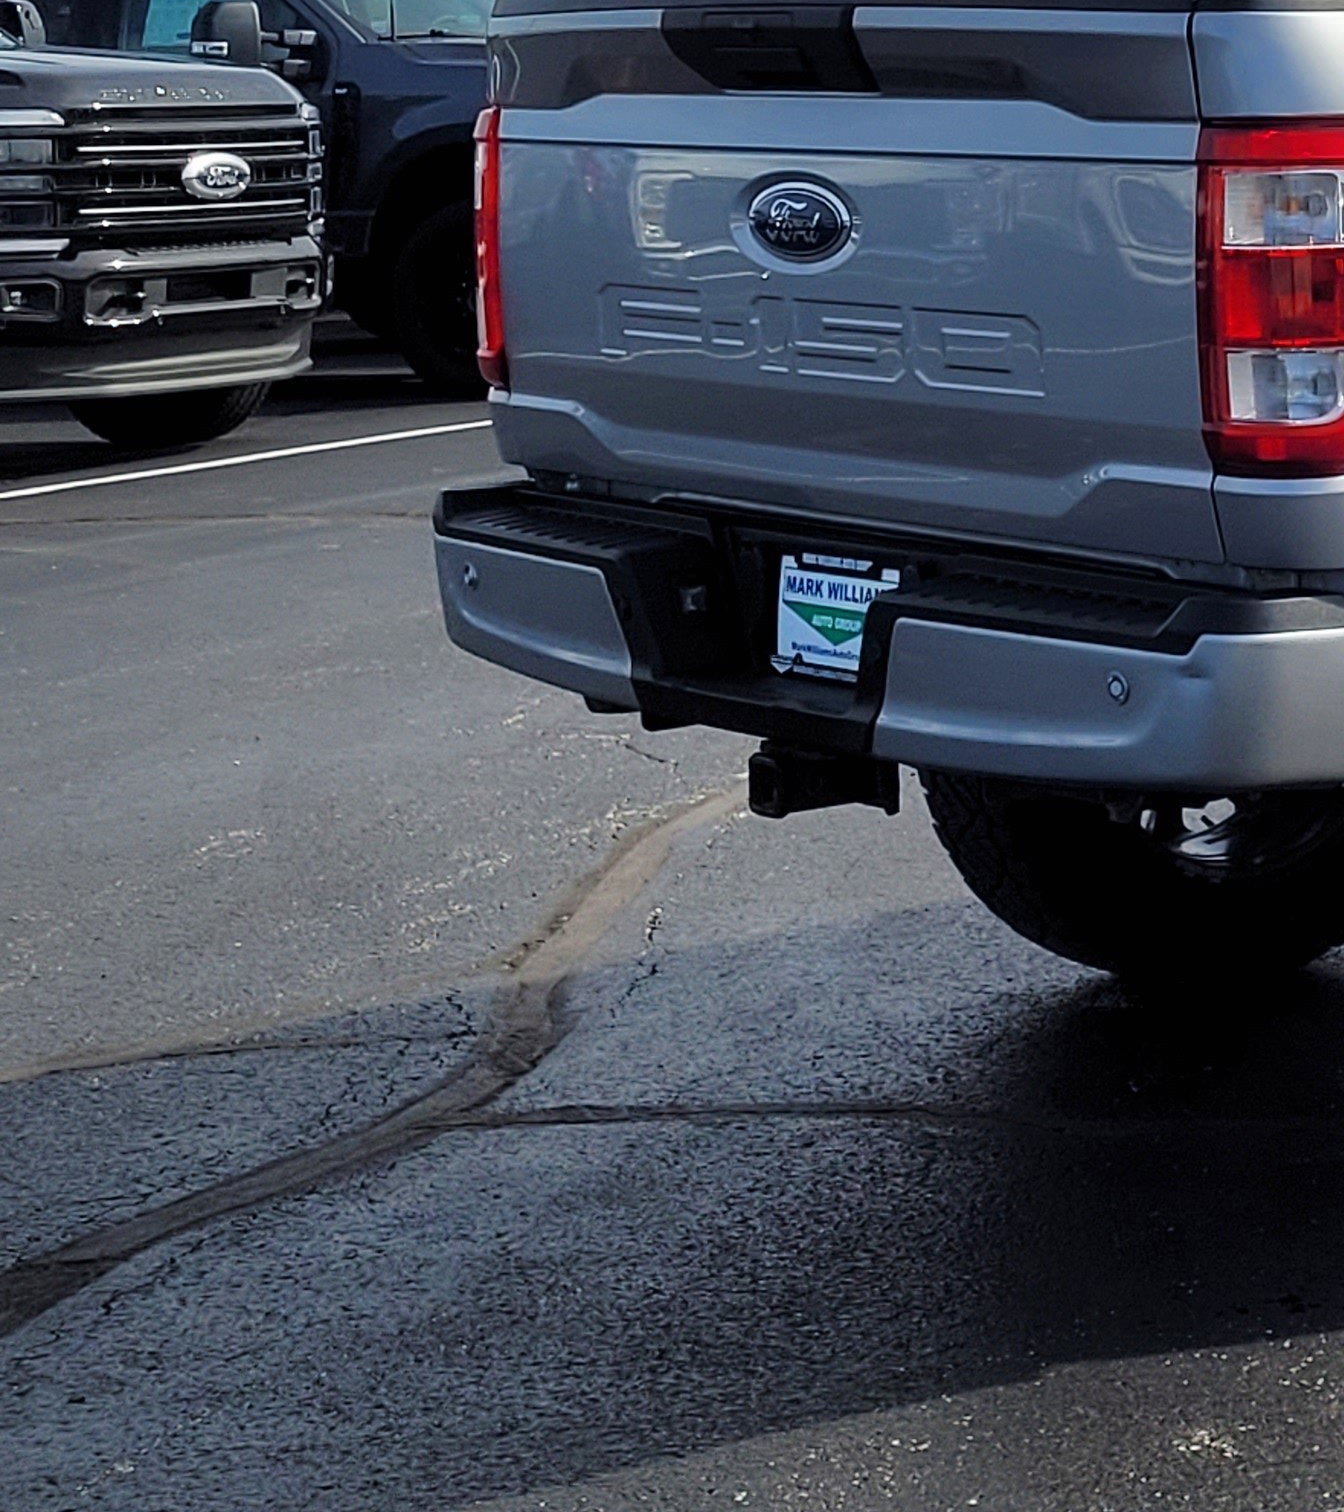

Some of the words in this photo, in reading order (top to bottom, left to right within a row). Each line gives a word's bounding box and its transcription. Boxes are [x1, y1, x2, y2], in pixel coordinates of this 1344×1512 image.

[765, 198, 822, 244] Ford
[599, 283, 1046, 398] F-150
[786, 575, 824, 599] MARK
